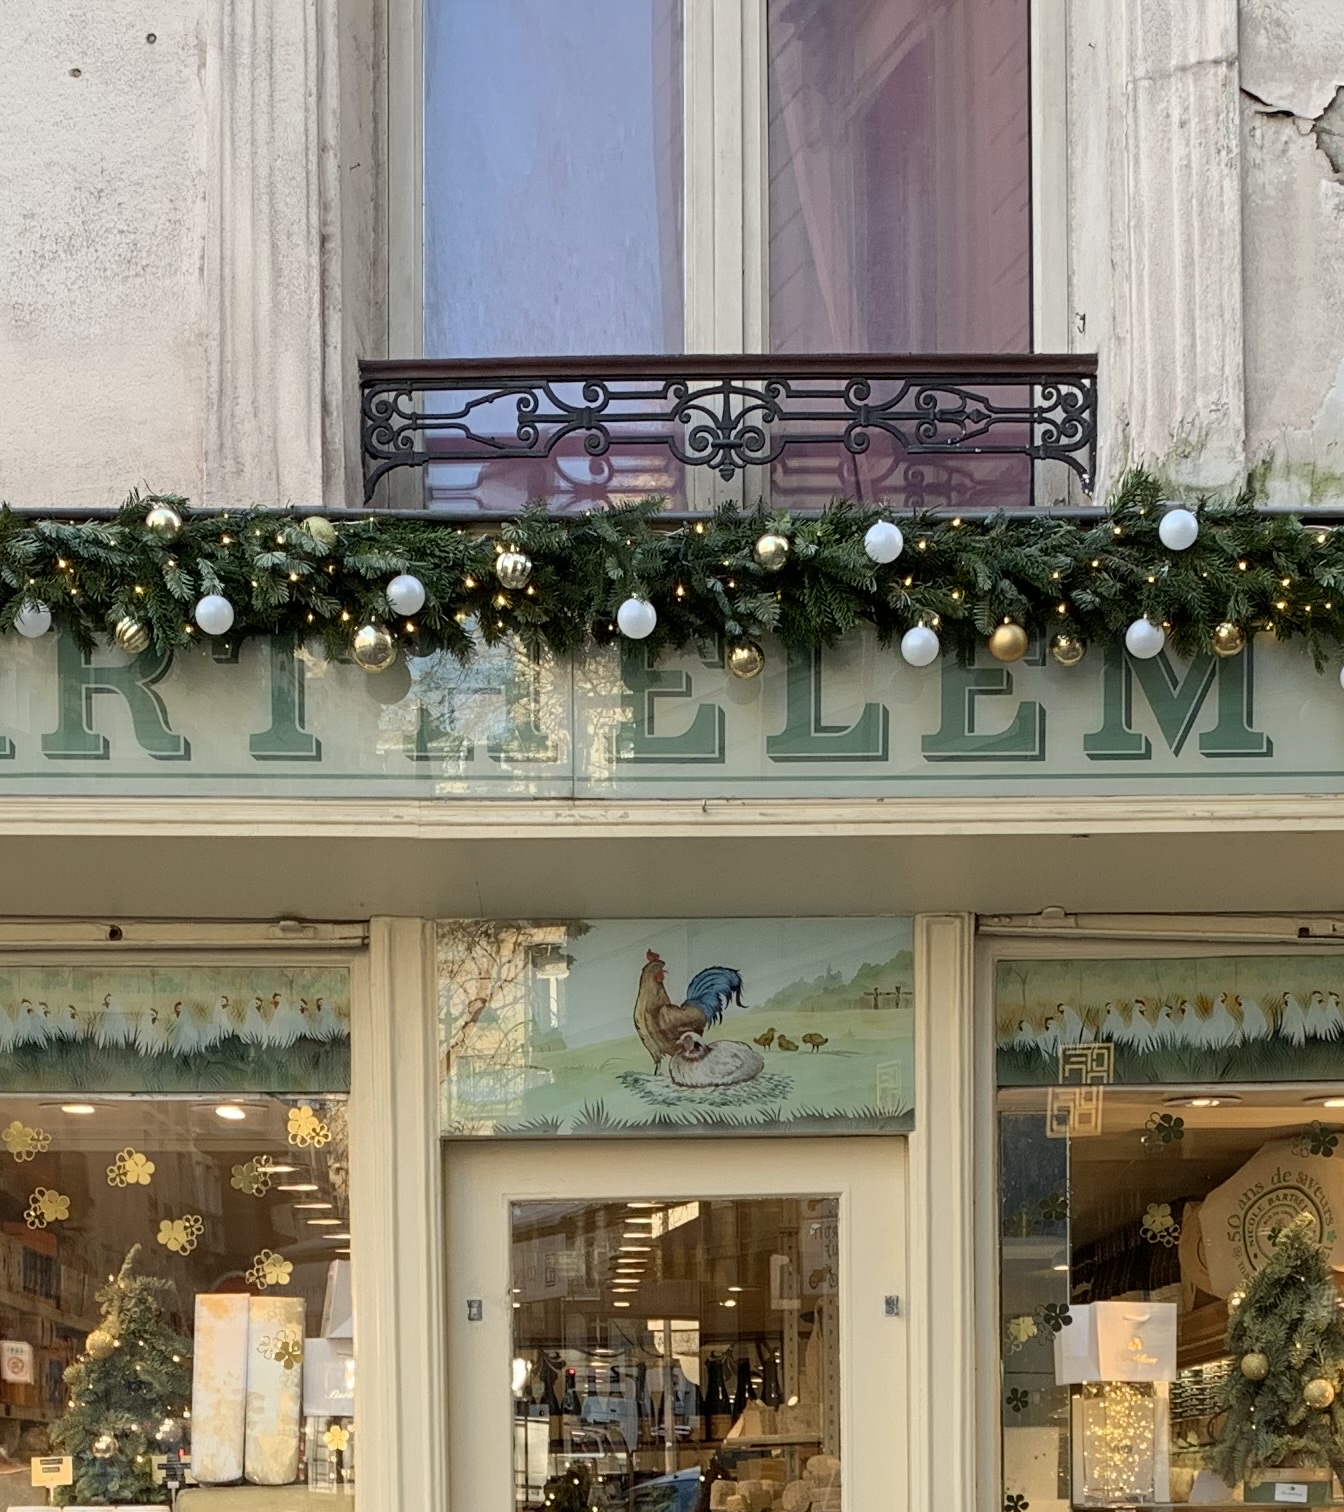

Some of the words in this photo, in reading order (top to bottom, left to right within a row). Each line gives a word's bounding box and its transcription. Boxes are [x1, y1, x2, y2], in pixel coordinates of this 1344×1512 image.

[1238, 1181, 1265, 1211] ans
[1271, 1167, 1293, 1185] de
[1296, 1171, 1334, 1227] saveurs
[1249, 1204, 1266, 1248] NICOLE
